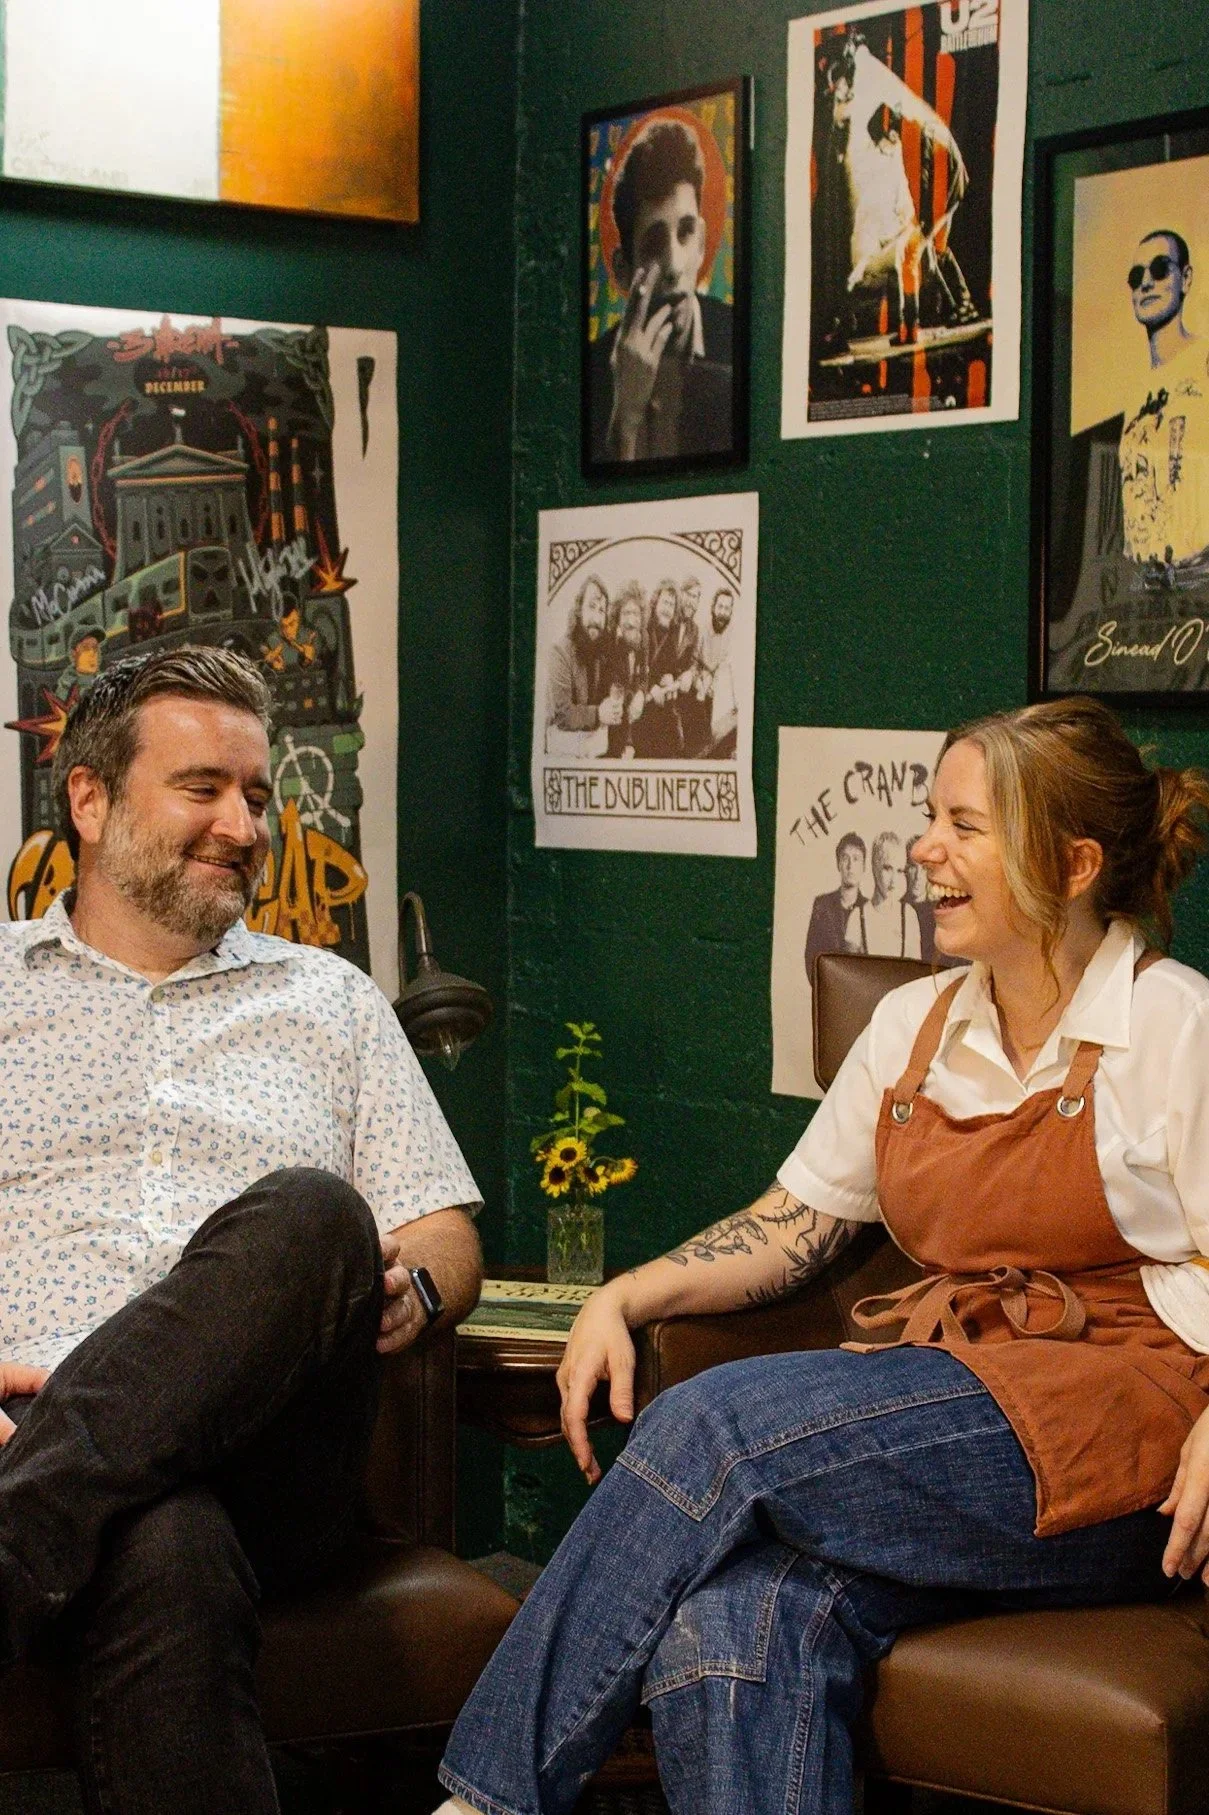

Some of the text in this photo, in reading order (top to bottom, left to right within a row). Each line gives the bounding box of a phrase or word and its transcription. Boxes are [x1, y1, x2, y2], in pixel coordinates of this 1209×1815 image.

[940, 0, 998, 34] U2
[145, 380, 205, 394] DECEMBER
[562, 775, 716, 812] THE DUBLINERS
[789, 760, 930, 846] THE CRANB
